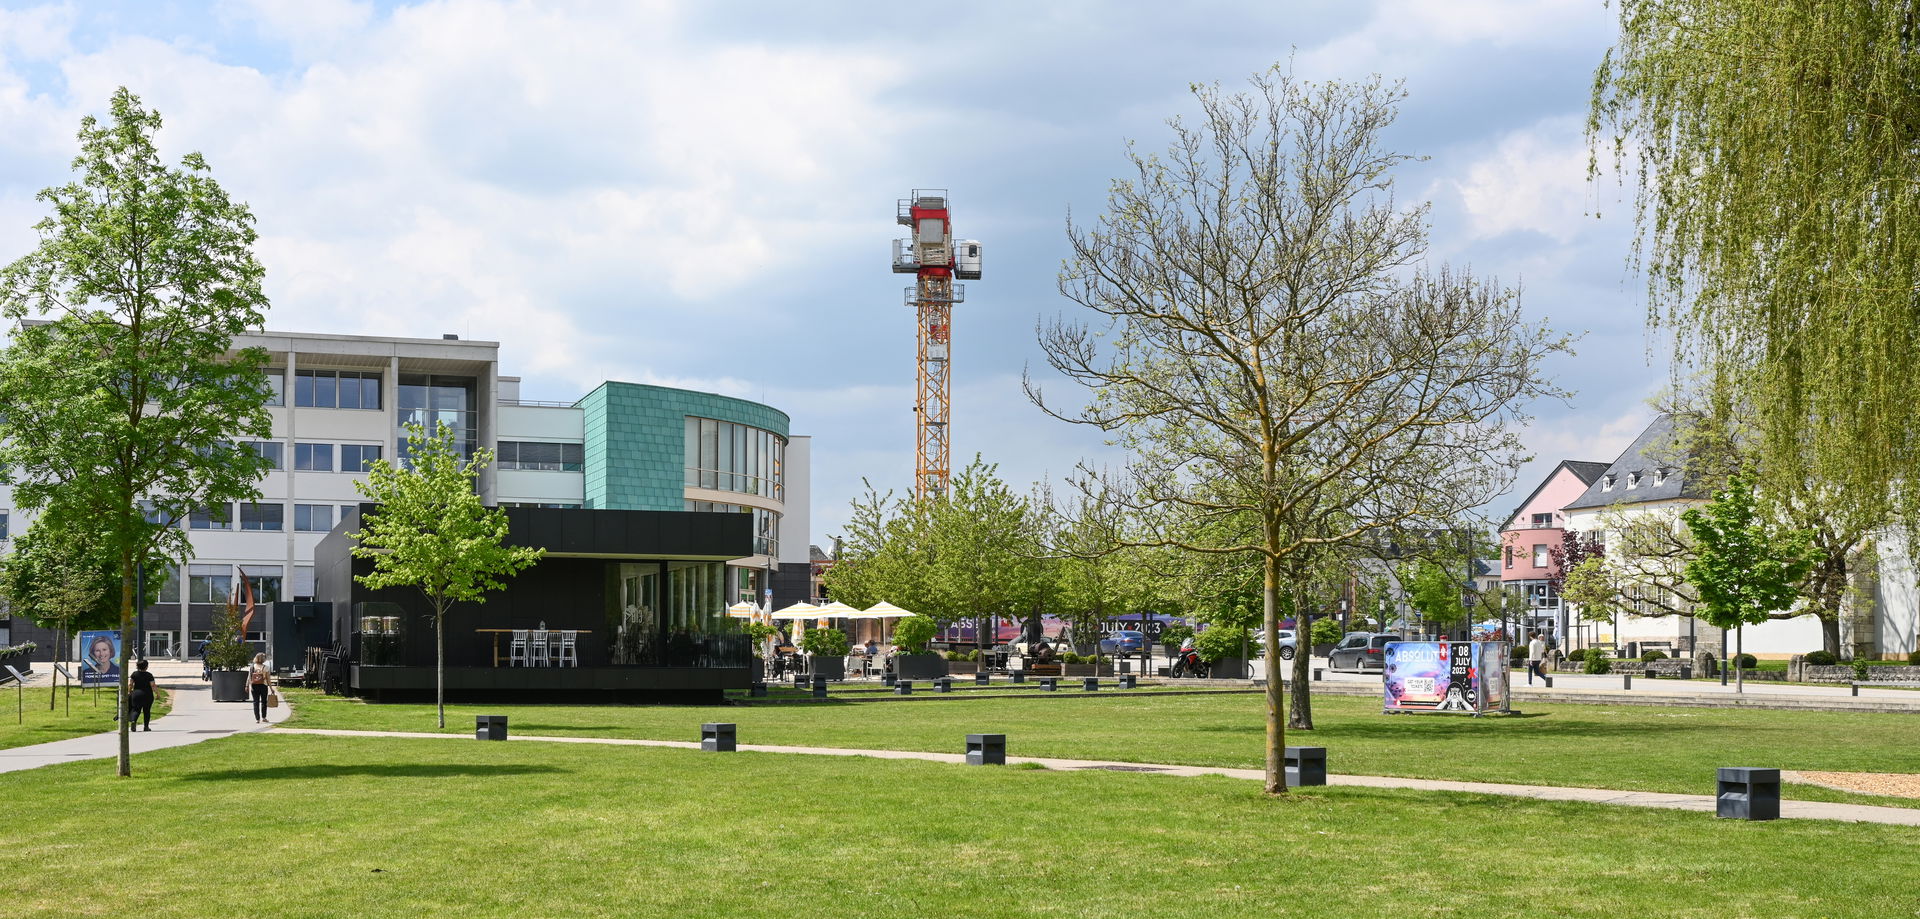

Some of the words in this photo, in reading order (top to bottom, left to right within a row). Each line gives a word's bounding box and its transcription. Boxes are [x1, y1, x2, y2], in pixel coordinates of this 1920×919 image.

[1100, 622, 1128, 633] JULY
[1395, 650, 1440, 662] ABSOLUT
[1458, 645, 1469, 656] 08
[1455, 657, 1471, 666] JULY
[1452, 666, 1466, 674] 2023
